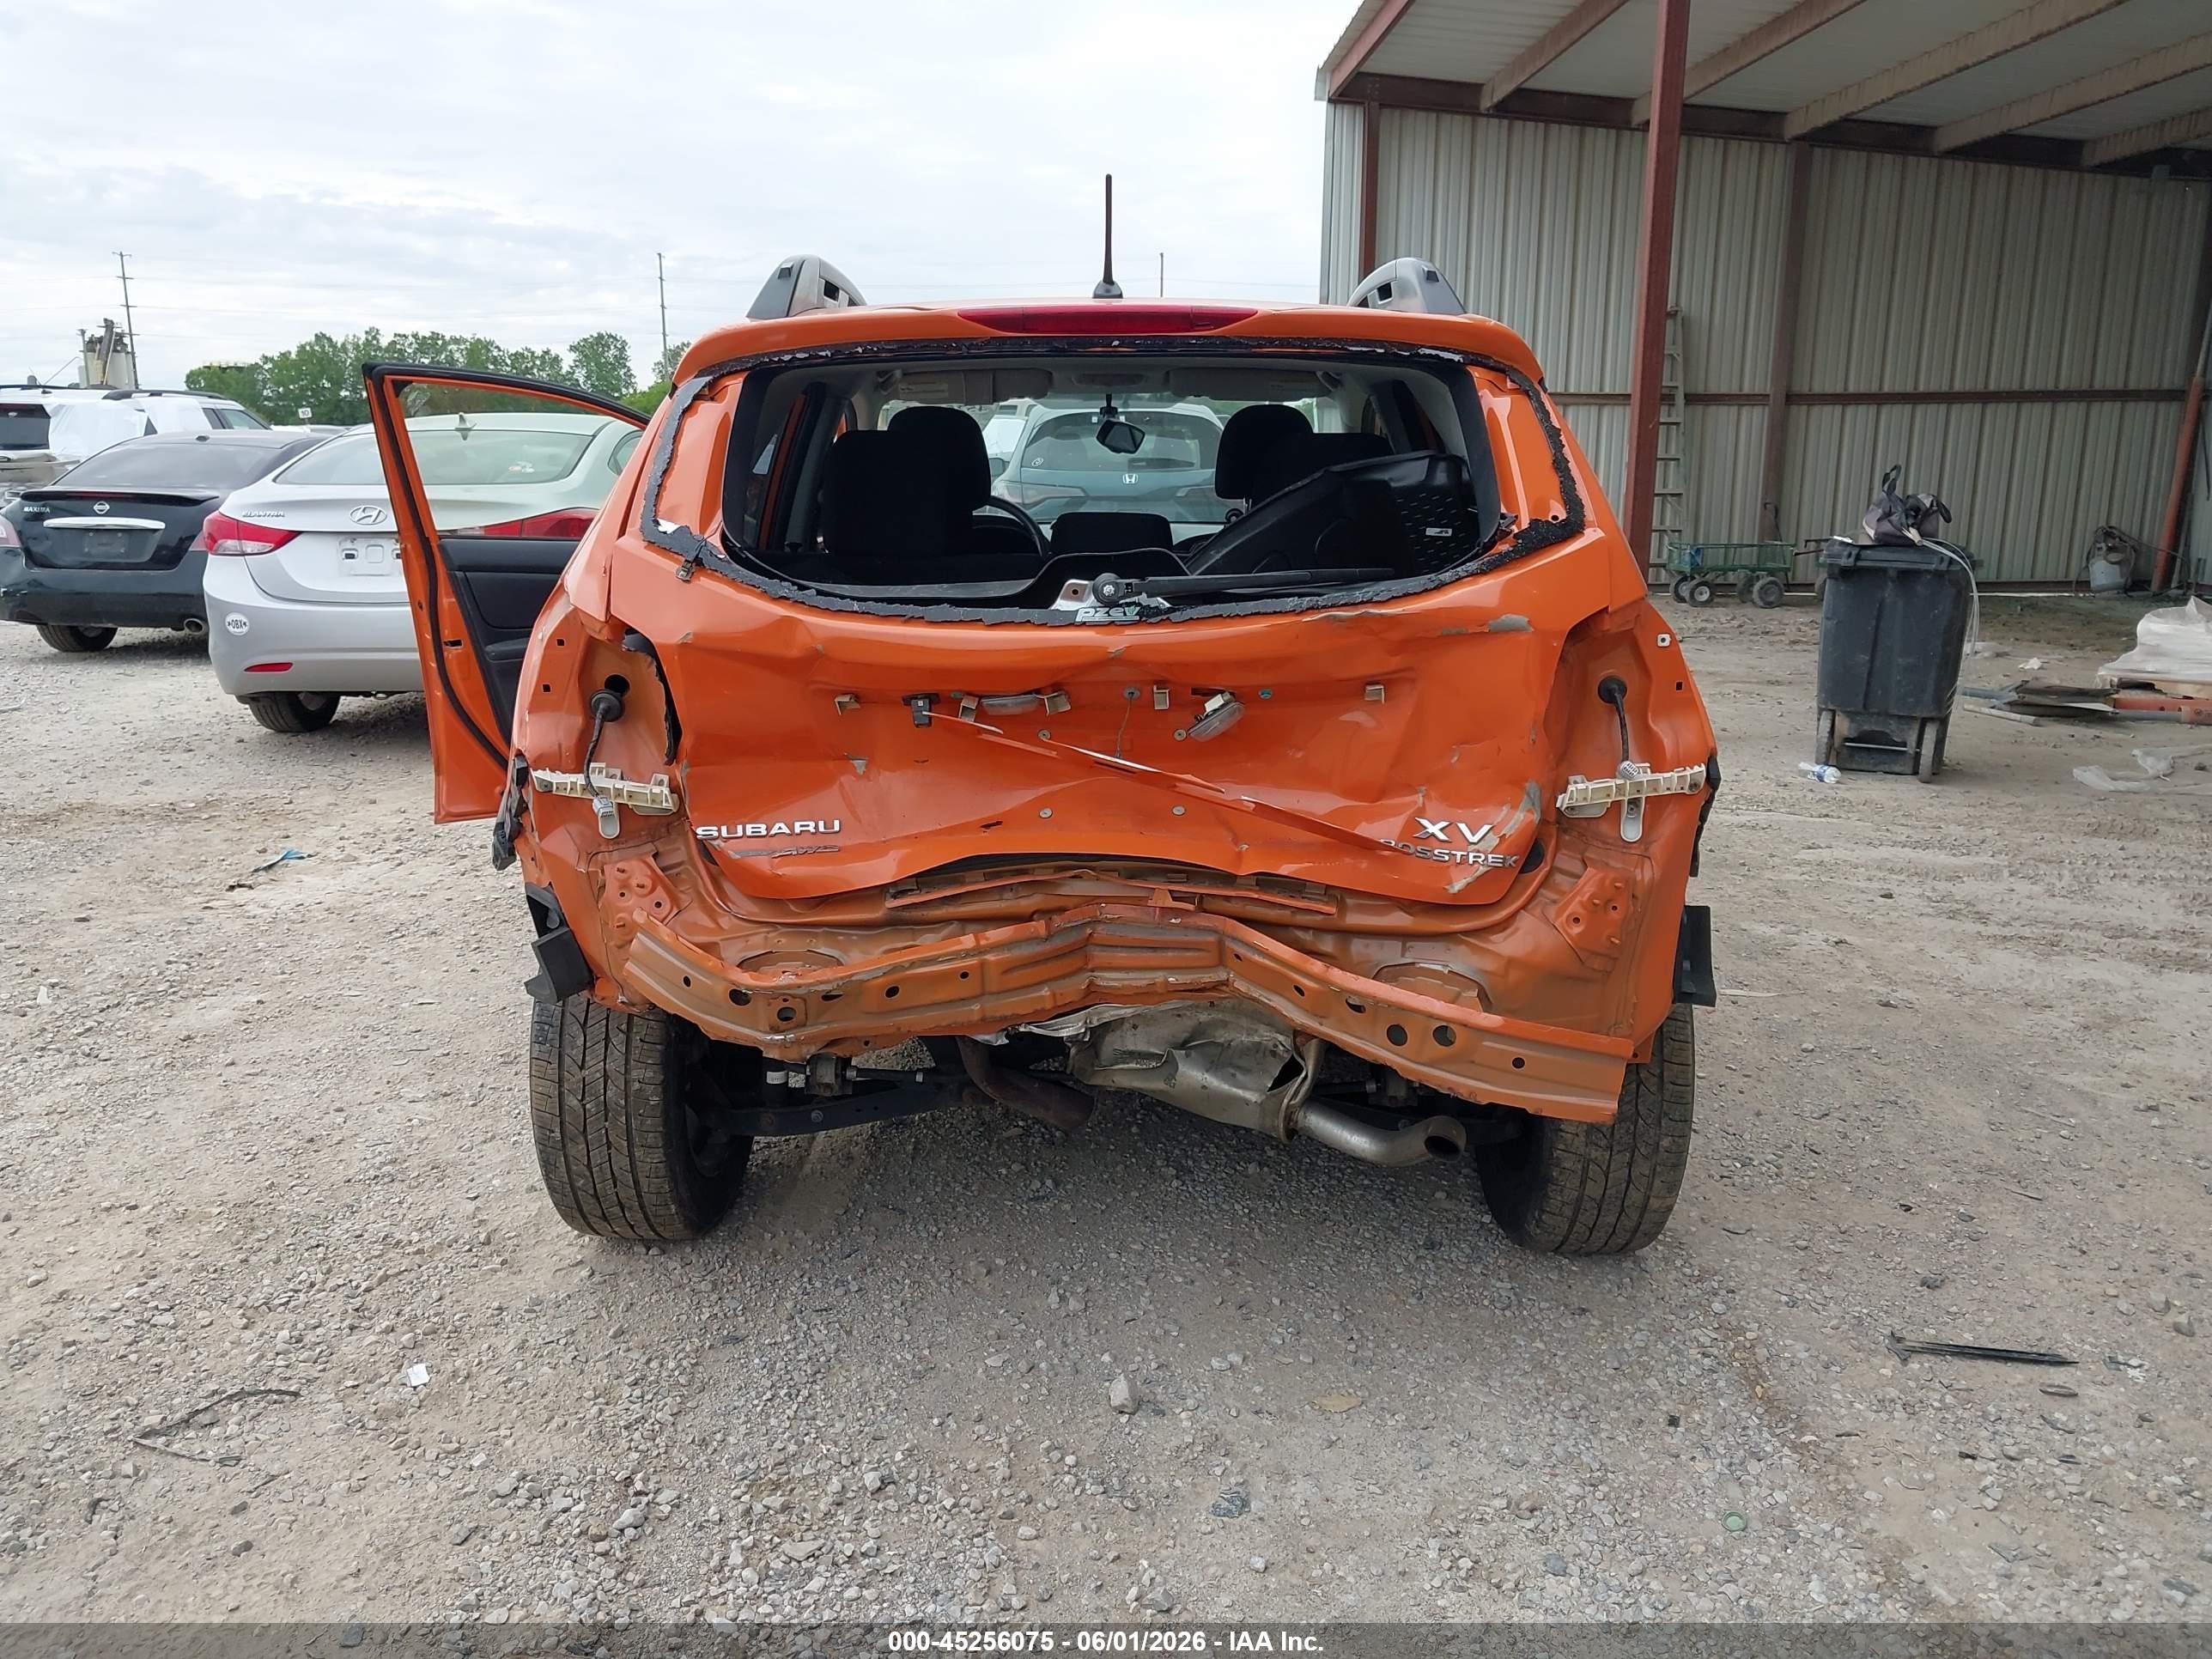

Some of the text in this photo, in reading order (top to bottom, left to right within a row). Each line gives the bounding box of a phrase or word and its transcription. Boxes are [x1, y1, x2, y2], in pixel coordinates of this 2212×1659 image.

[696, 818, 842, 841] SUBARU
[1413, 817, 1495, 844] XV
[1380, 837, 1520, 867] ROSSTREK
